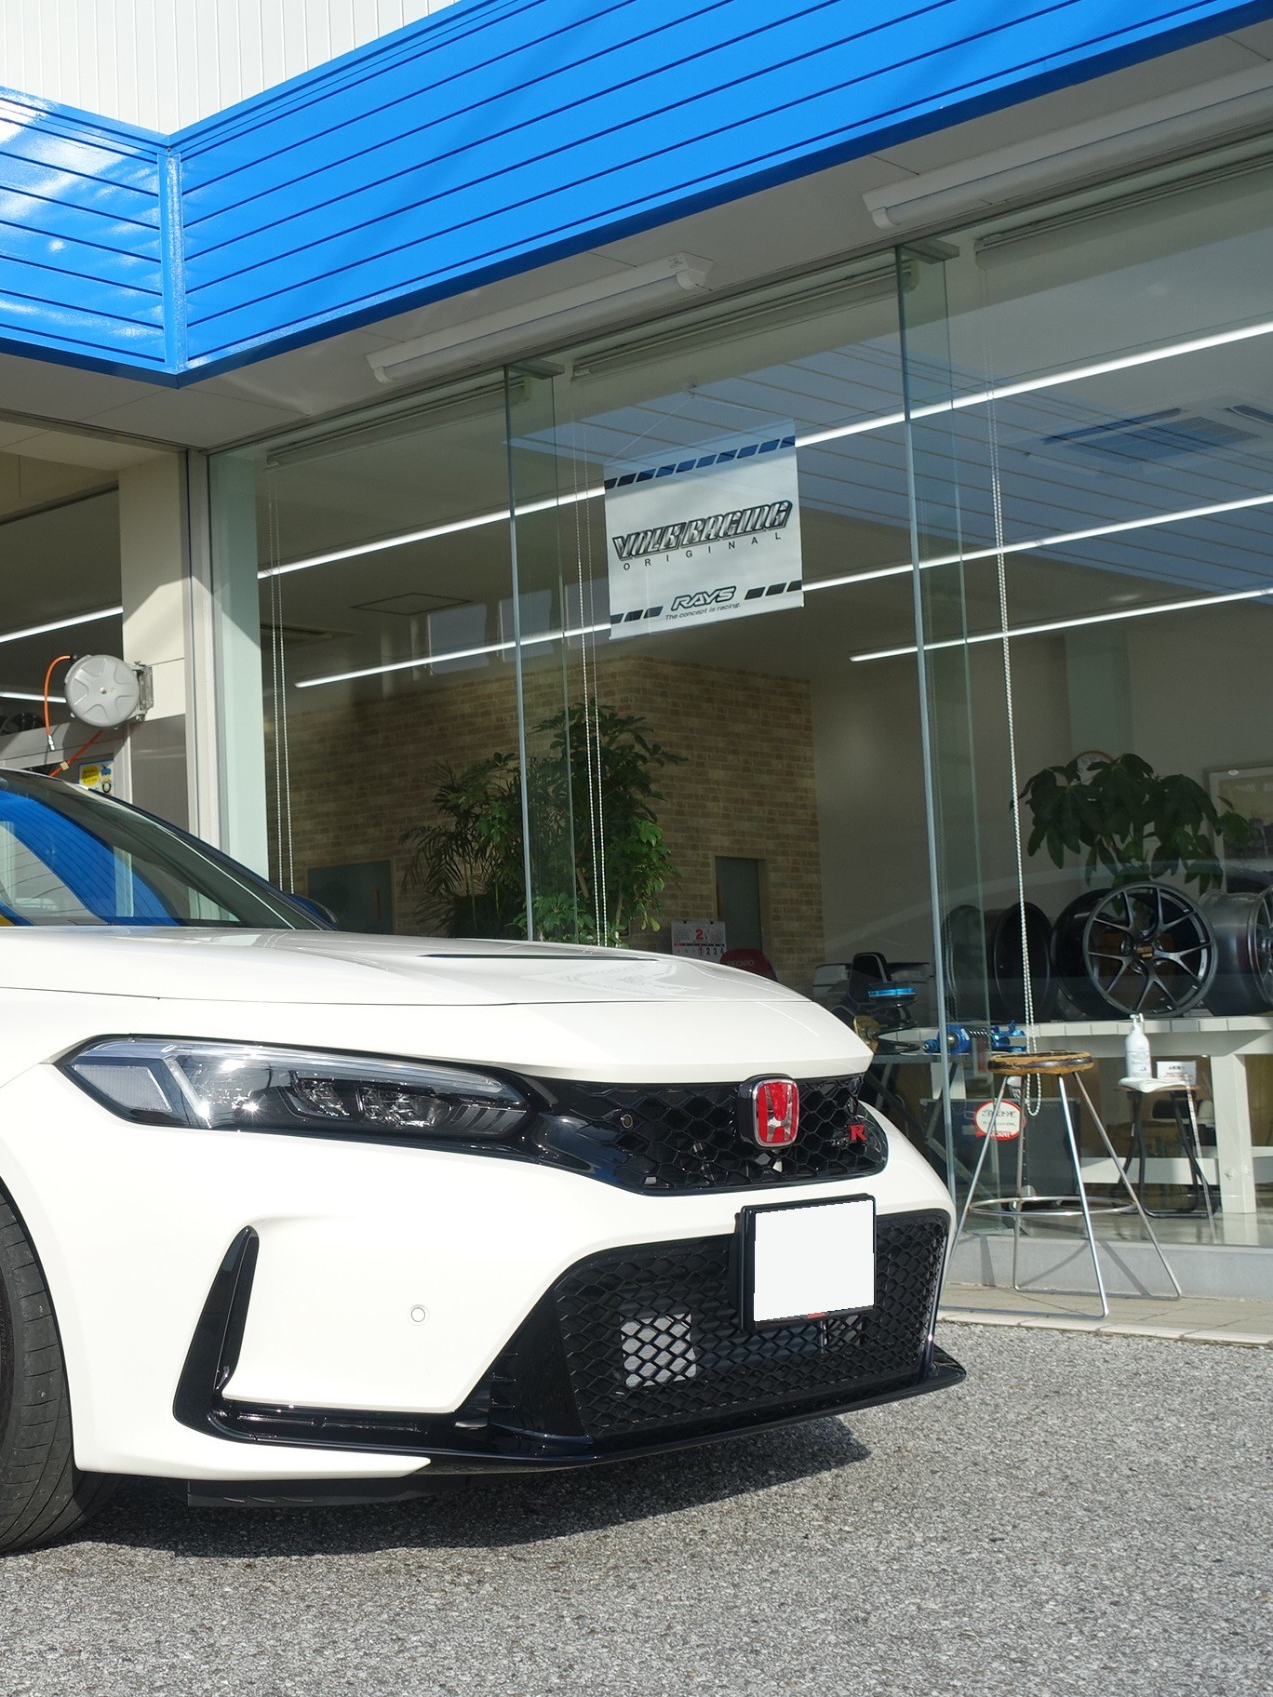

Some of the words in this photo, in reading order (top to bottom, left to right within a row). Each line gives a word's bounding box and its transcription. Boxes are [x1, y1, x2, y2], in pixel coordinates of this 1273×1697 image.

[612, 522, 686, 561] VOLK
[680, 500, 793, 549] RACING
[623, 532, 781, 571] ORIGINAL
[671, 585, 737, 611] RAYS
[665, 613, 678, 621] The
[679, 608, 708, 619] concept
[695, 928, 704, 940] 2
[848, 1124, 867, 1142] R
